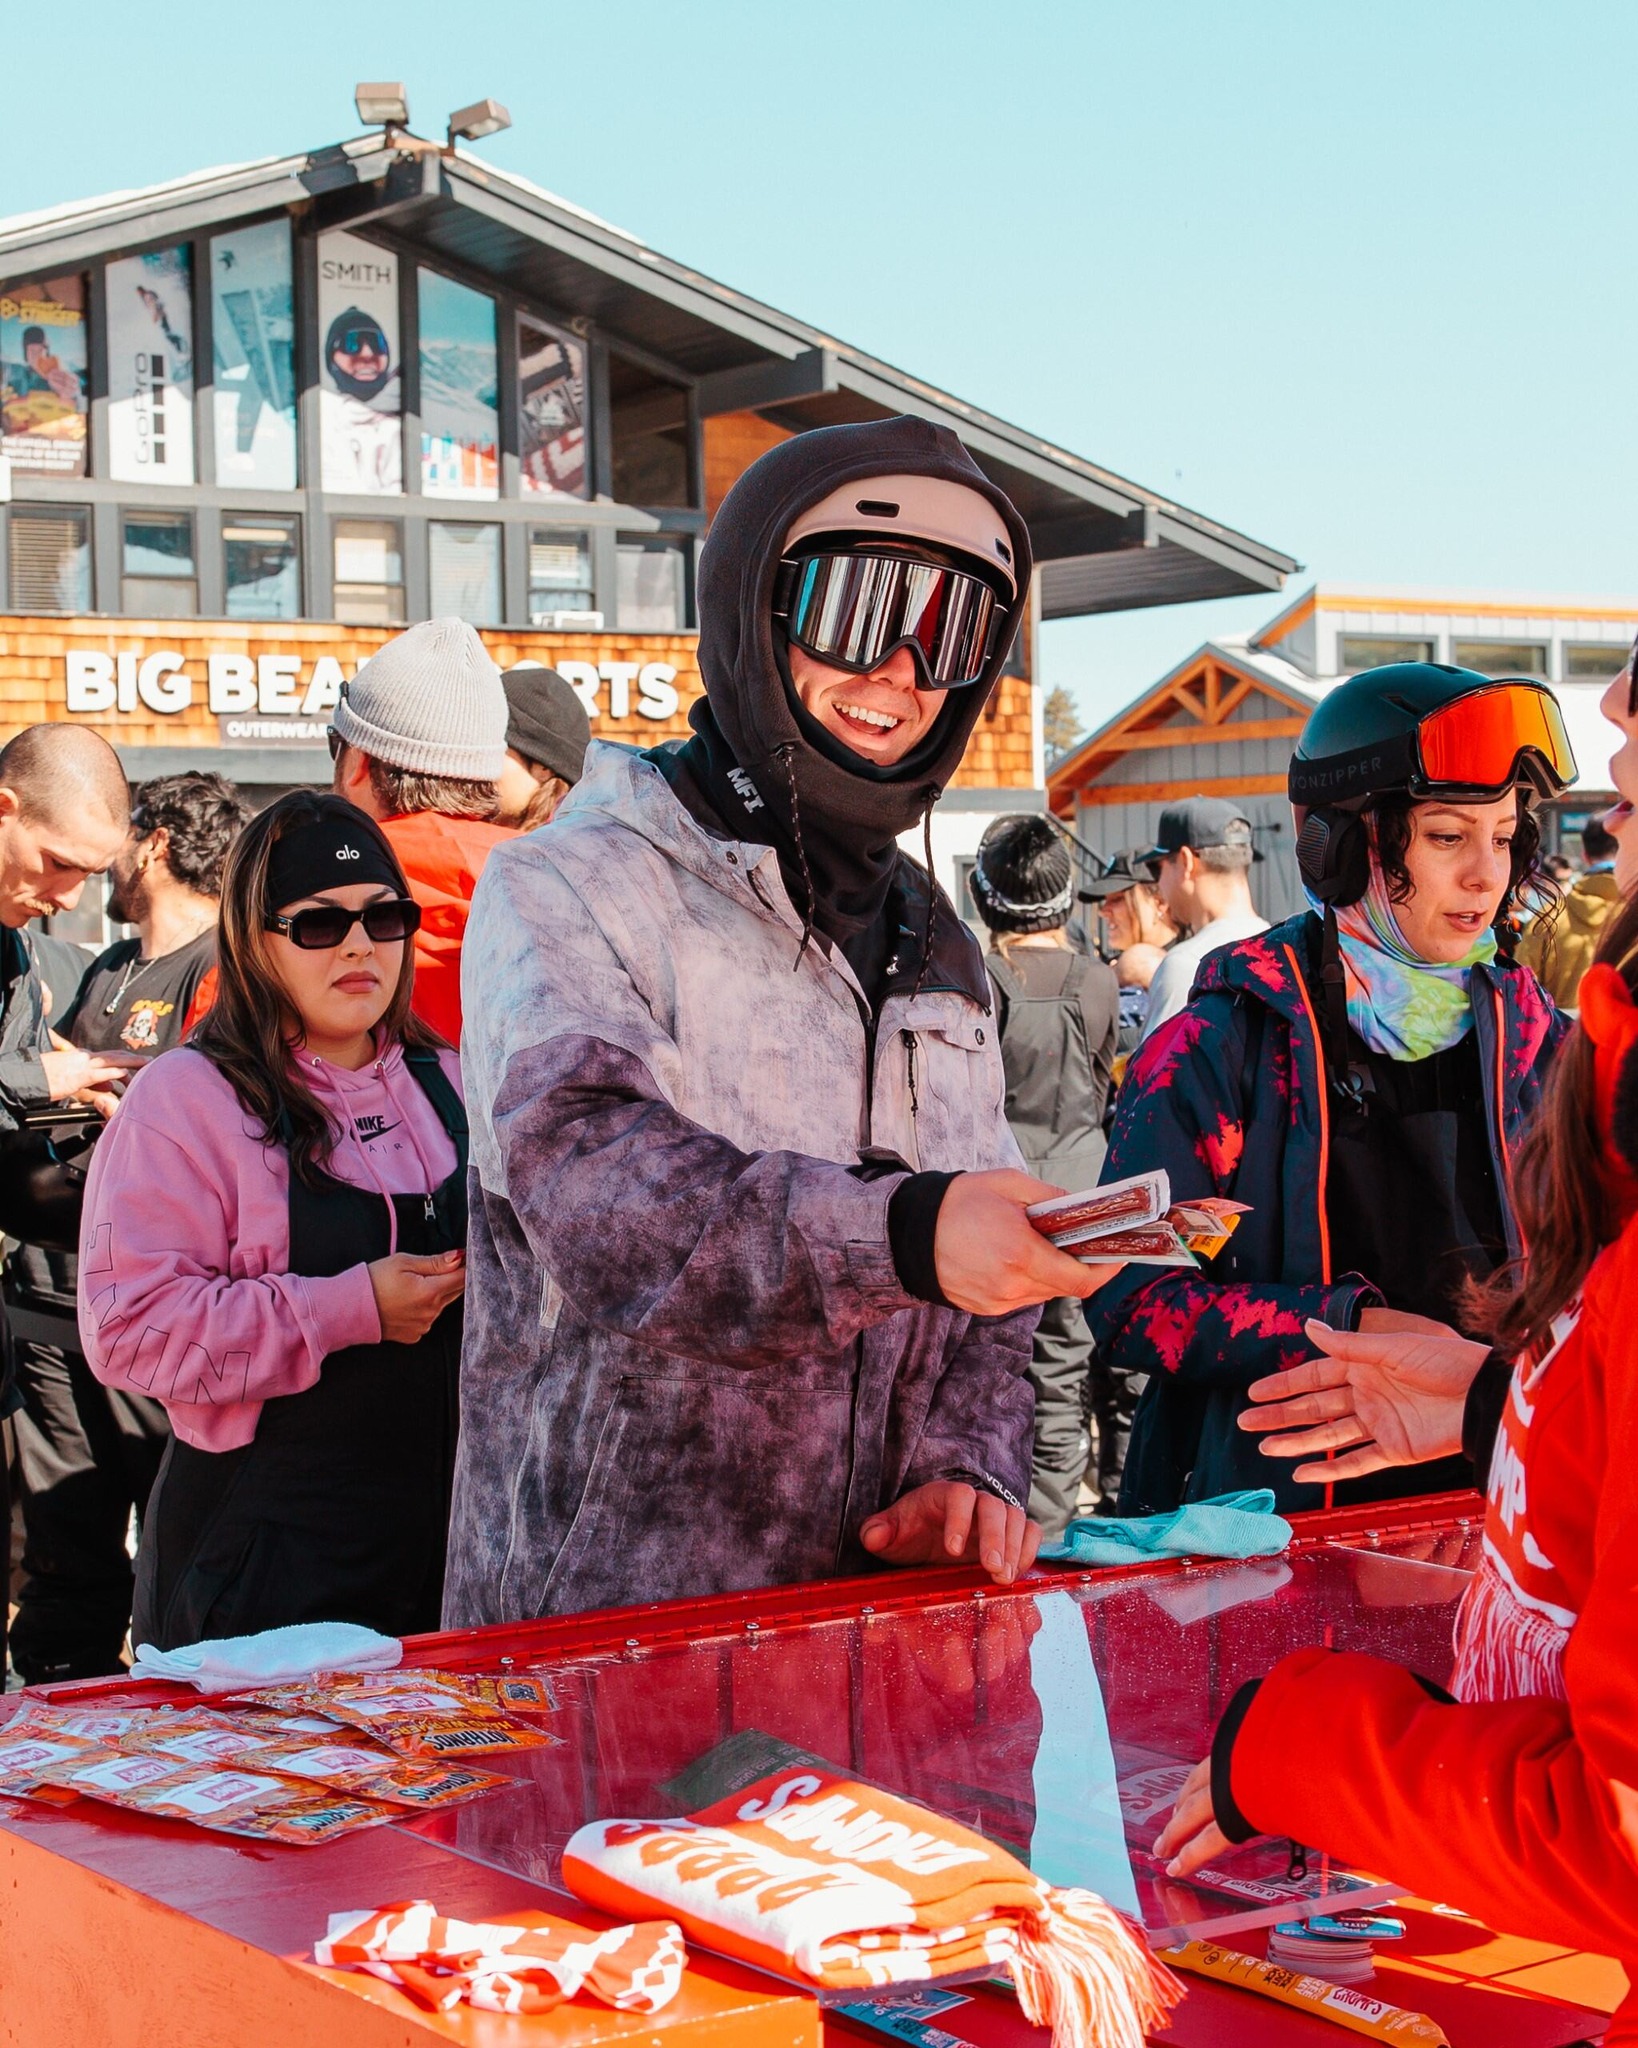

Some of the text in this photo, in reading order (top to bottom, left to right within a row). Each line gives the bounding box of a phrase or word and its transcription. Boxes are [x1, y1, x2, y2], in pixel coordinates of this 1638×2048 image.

[322, 260, 392, 284] SMITH
[133, 352, 149, 464] GoPro
[66, 650, 192, 713] BIG
[208, 653, 371, 714] BEA
[335, 844, 360, 860] alo
[353, 1115, 386, 1132] NIKE
[985, 1472, 1025, 1512] VOLCOM
